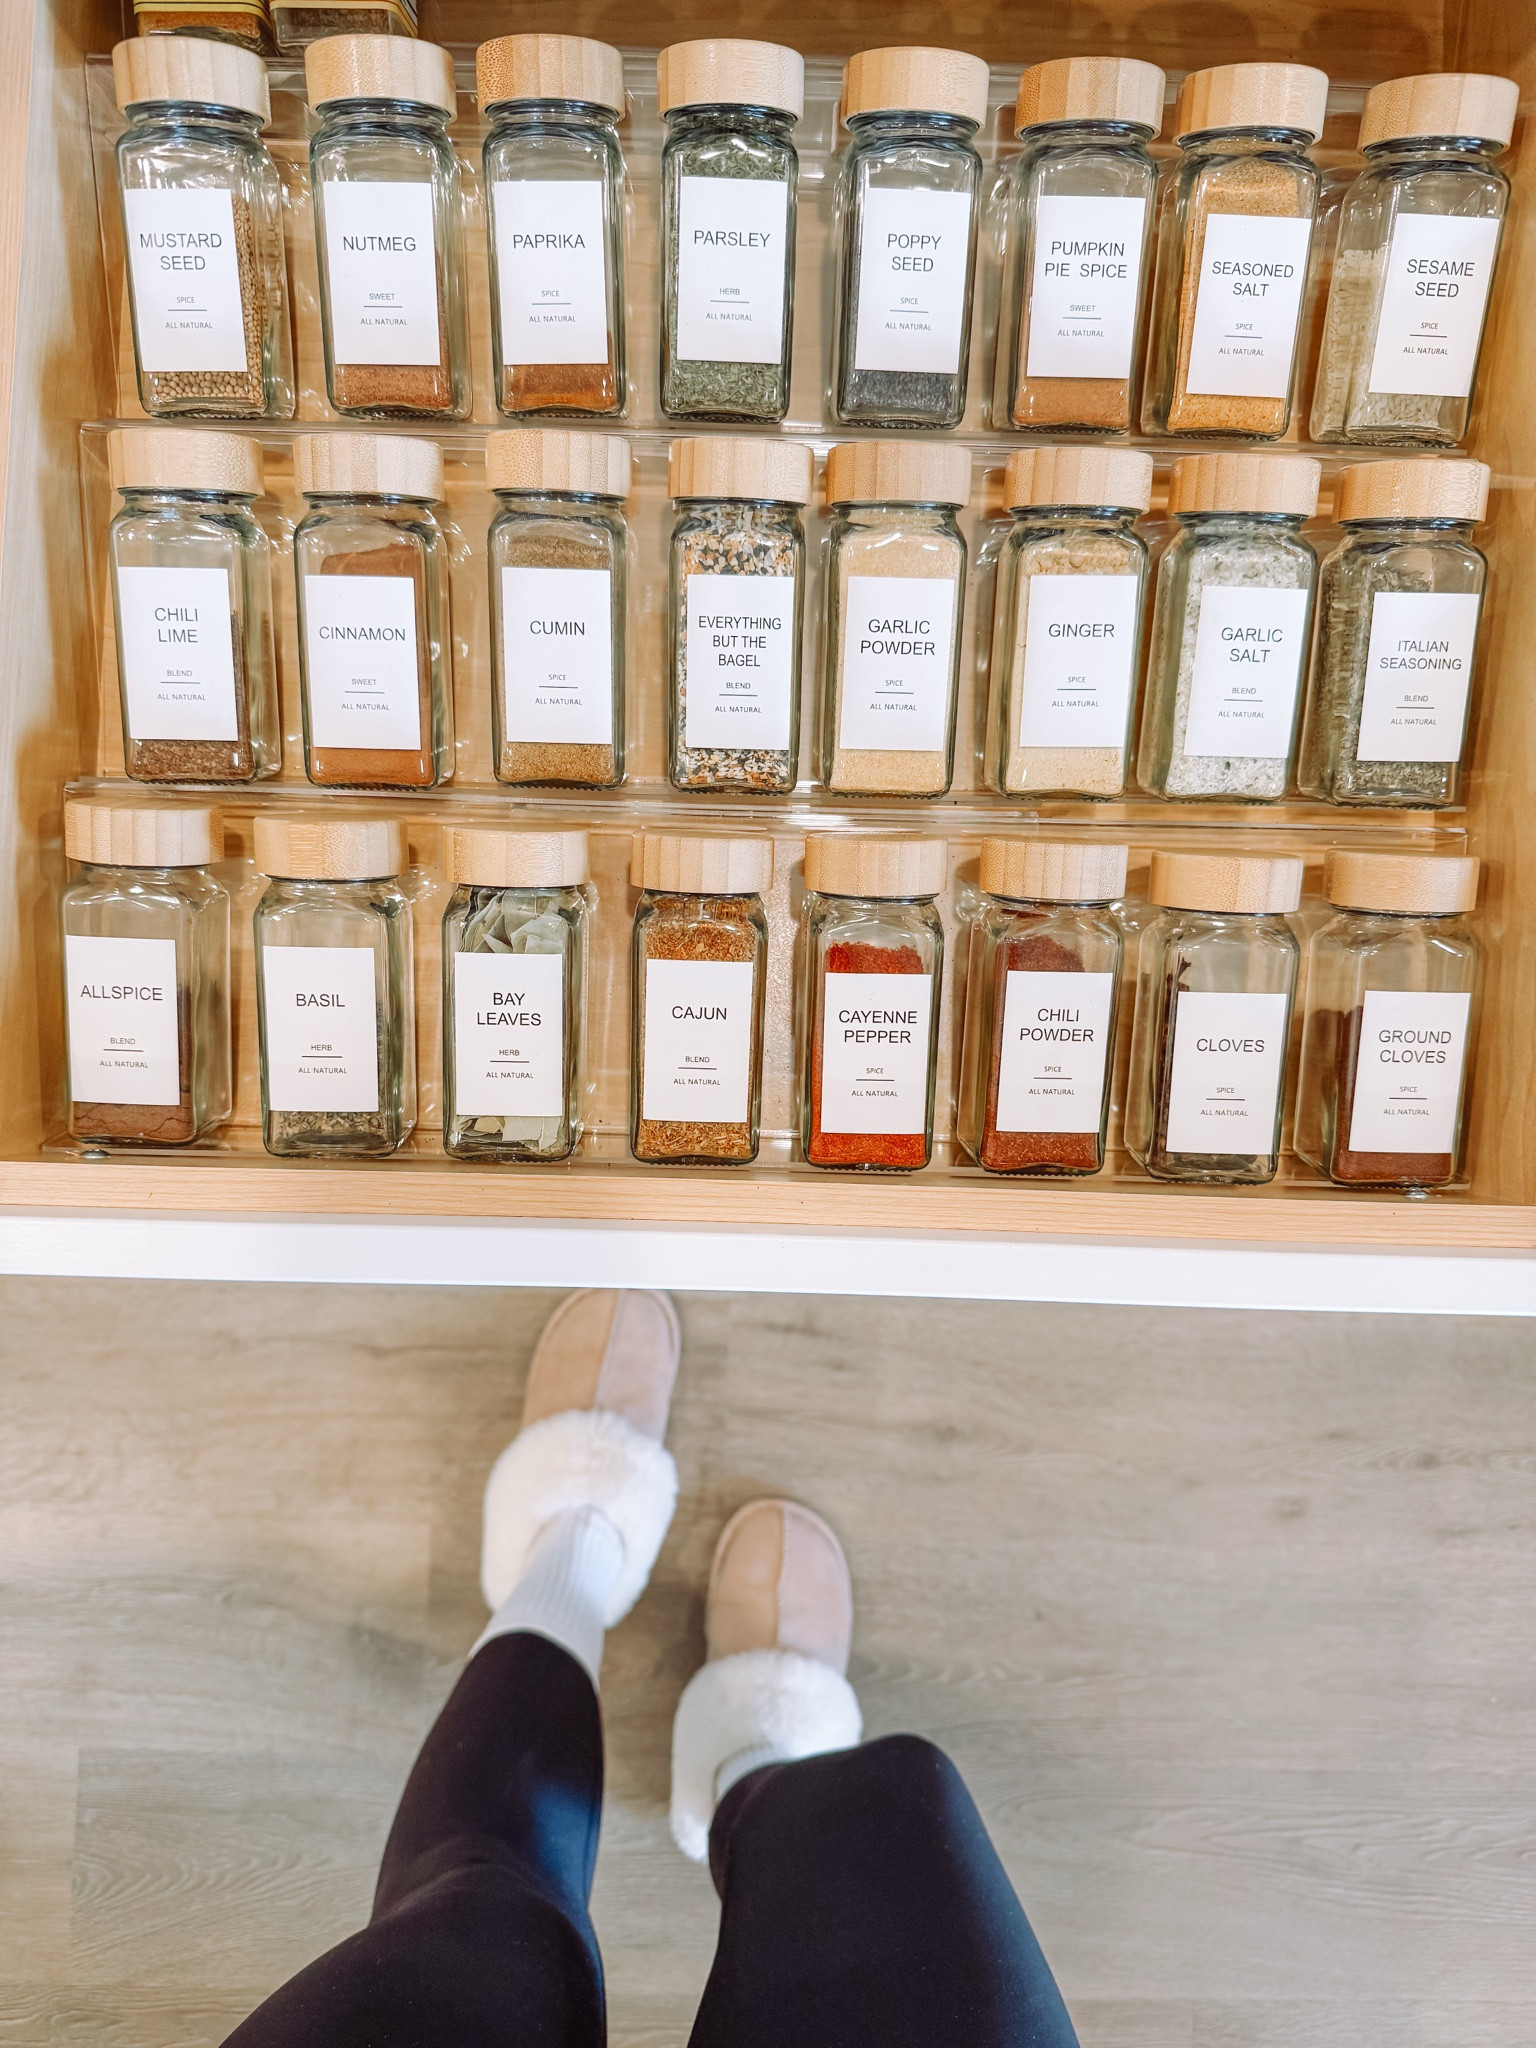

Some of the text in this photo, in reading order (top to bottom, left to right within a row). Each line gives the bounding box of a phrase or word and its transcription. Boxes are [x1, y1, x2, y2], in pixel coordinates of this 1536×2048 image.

[139, 233, 223, 248] MUSTARD
[512, 234, 586, 248] PAPRIKA
[693, 230, 771, 247] PARSLEY
[887, 234, 942, 250] POPPY
[342, 236, 417, 251] NUTMEG
[1051, 241, 1125, 256] PUMPKIN
[160, 256, 206, 270] SEED
[891, 256, 934, 272] SEED
[1406, 259, 1476, 276] SESAME
[1044, 263, 1128, 278] PIE SPICE
[1211, 261, 1294, 278] SEASONED
[541, 289, 560, 298] SPICE
[719, 287, 741, 296] HERB
[1232, 282, 1270, 296] SALT
[1414, 282, 1460, 297] SEED
[176, 296, 196, 304] SPICE
[368, 292, 396, 301] SWEET
[900, 297, 919, 305] SPICE
[1069, 304, 1096, 313] SWEET
[360, 317, 408, 326] ALL NATURAL
[528, 315, 577, 323] ALL NATURAL
[705, 312, 753, 322] ALL NATURAL
[165, 321, 213, 329] ALL NATURAL
[884, 322, 931, 331] ALL NATURAL
[1235, 322, 1254, 331] SPICE
[1420, 321, 1439, 330] SPICE
[1057, 329, 1104, 338] ALL NATURAL
[1218, 347, 1265, 357] ALL NATURAL
[1402, 346, 1449, 356] ALL NATURAL
[154, 608, 199, 622] CHILI
[698, 616, 782, 630] EVERYTHING
[867, 619, 931, 634] GARLIC
[529, 621, 585, 636] CUMIN
[1048, 624, 1115, 637] GINGER
[157, 629, 199, 643] LIME
[318, 626, 406, 641] CINNAMON
[1220, 627, 1283, 642] GARLIC
[712, 635, 767, 648] BUT THE
[860, 640, 936, 655] POWDER
[1397, 641, 1450, 652] ITALIAN
[1229, 648, 1272, 663] SALT
[718, 654, 761, 667] BAGEL
[1379, 657, 1462, 670] SEASONING
[166, 669, 193, 677] BLEND
[548, 673, 567, 681] SPICE
[351, 678, 377, 686] SWEET
[885, 679, 904, 687] SPICE
[1067, 676, 1086, 684] SPICE
[725, 681, 751, 690] BLEND
[1231, 687, 1257, 695] BLEND
[157, 693, 206, 701] ALL NATURAL
[535, 697, 583, 706] ALL NATURAL
[1403, 694, 1429, 703] BLEND
[356, 703, 391, 711] NATURAL
[869, 703, 917, 711] ALL NATURAL
[1051, 700, 1099, 708] ALL NATURAL
[714, 705, 762, 714] ALL NATURAL
[1217, 710, 1265, 719] ALL NATURAL
[1404, 718, 1437, 726] NATURAL
[79, 985, 164, 1001] ALLSPICE
[295, 994, 346, 1007] BASIL
[492, 992, 526, 1006] BAY
[671, 1006, 728, 1020] CAJUN
[838, 1010, 918, 1024] CAYENNE
[1037, 1009, 1080, 1022] CHILI
[476, 1012, 542, 1026] LEAVES
[843, 1030, 912, 1043] PEPPER
[1019, 1028, 1094, 1042] POWDER
[1378, 1030, 1452, 1044] GROUND
[109, 1037, 136, 1045] BLEND
[1196, 1039, 1265, 1052] CLOVES
[310, 1044, 333, 1052] HERB
[498, 1048, 521, 1057] HERB
[684, 1055, 711, 1064] BLEND
[1379, 1050, 1447, 1063] CLOVES
[114, 1060, 149, 1069] NATURAL
[1043, 1065, 1062, 1073] SPICE
[313, 1066, 348, 1075] NATURAL
[865, 1067, 885, 1075] SPICE
[485, 1071, 534, 1080] ALL NATURAL
[687, 1078, 721, 1086] NATURAL
[1042, 1088, 1076, 1096] NATURAL
[1216, 1086, 1235, 1094] SPICE
[1399, 1085, 1418, 1093] SPICE
[865, 1090, 898, 1098] NATURAL
[1214, 1109, 1249, 1117] NATURAL
[1397, 1108, 1430, 1116] NATURAL
